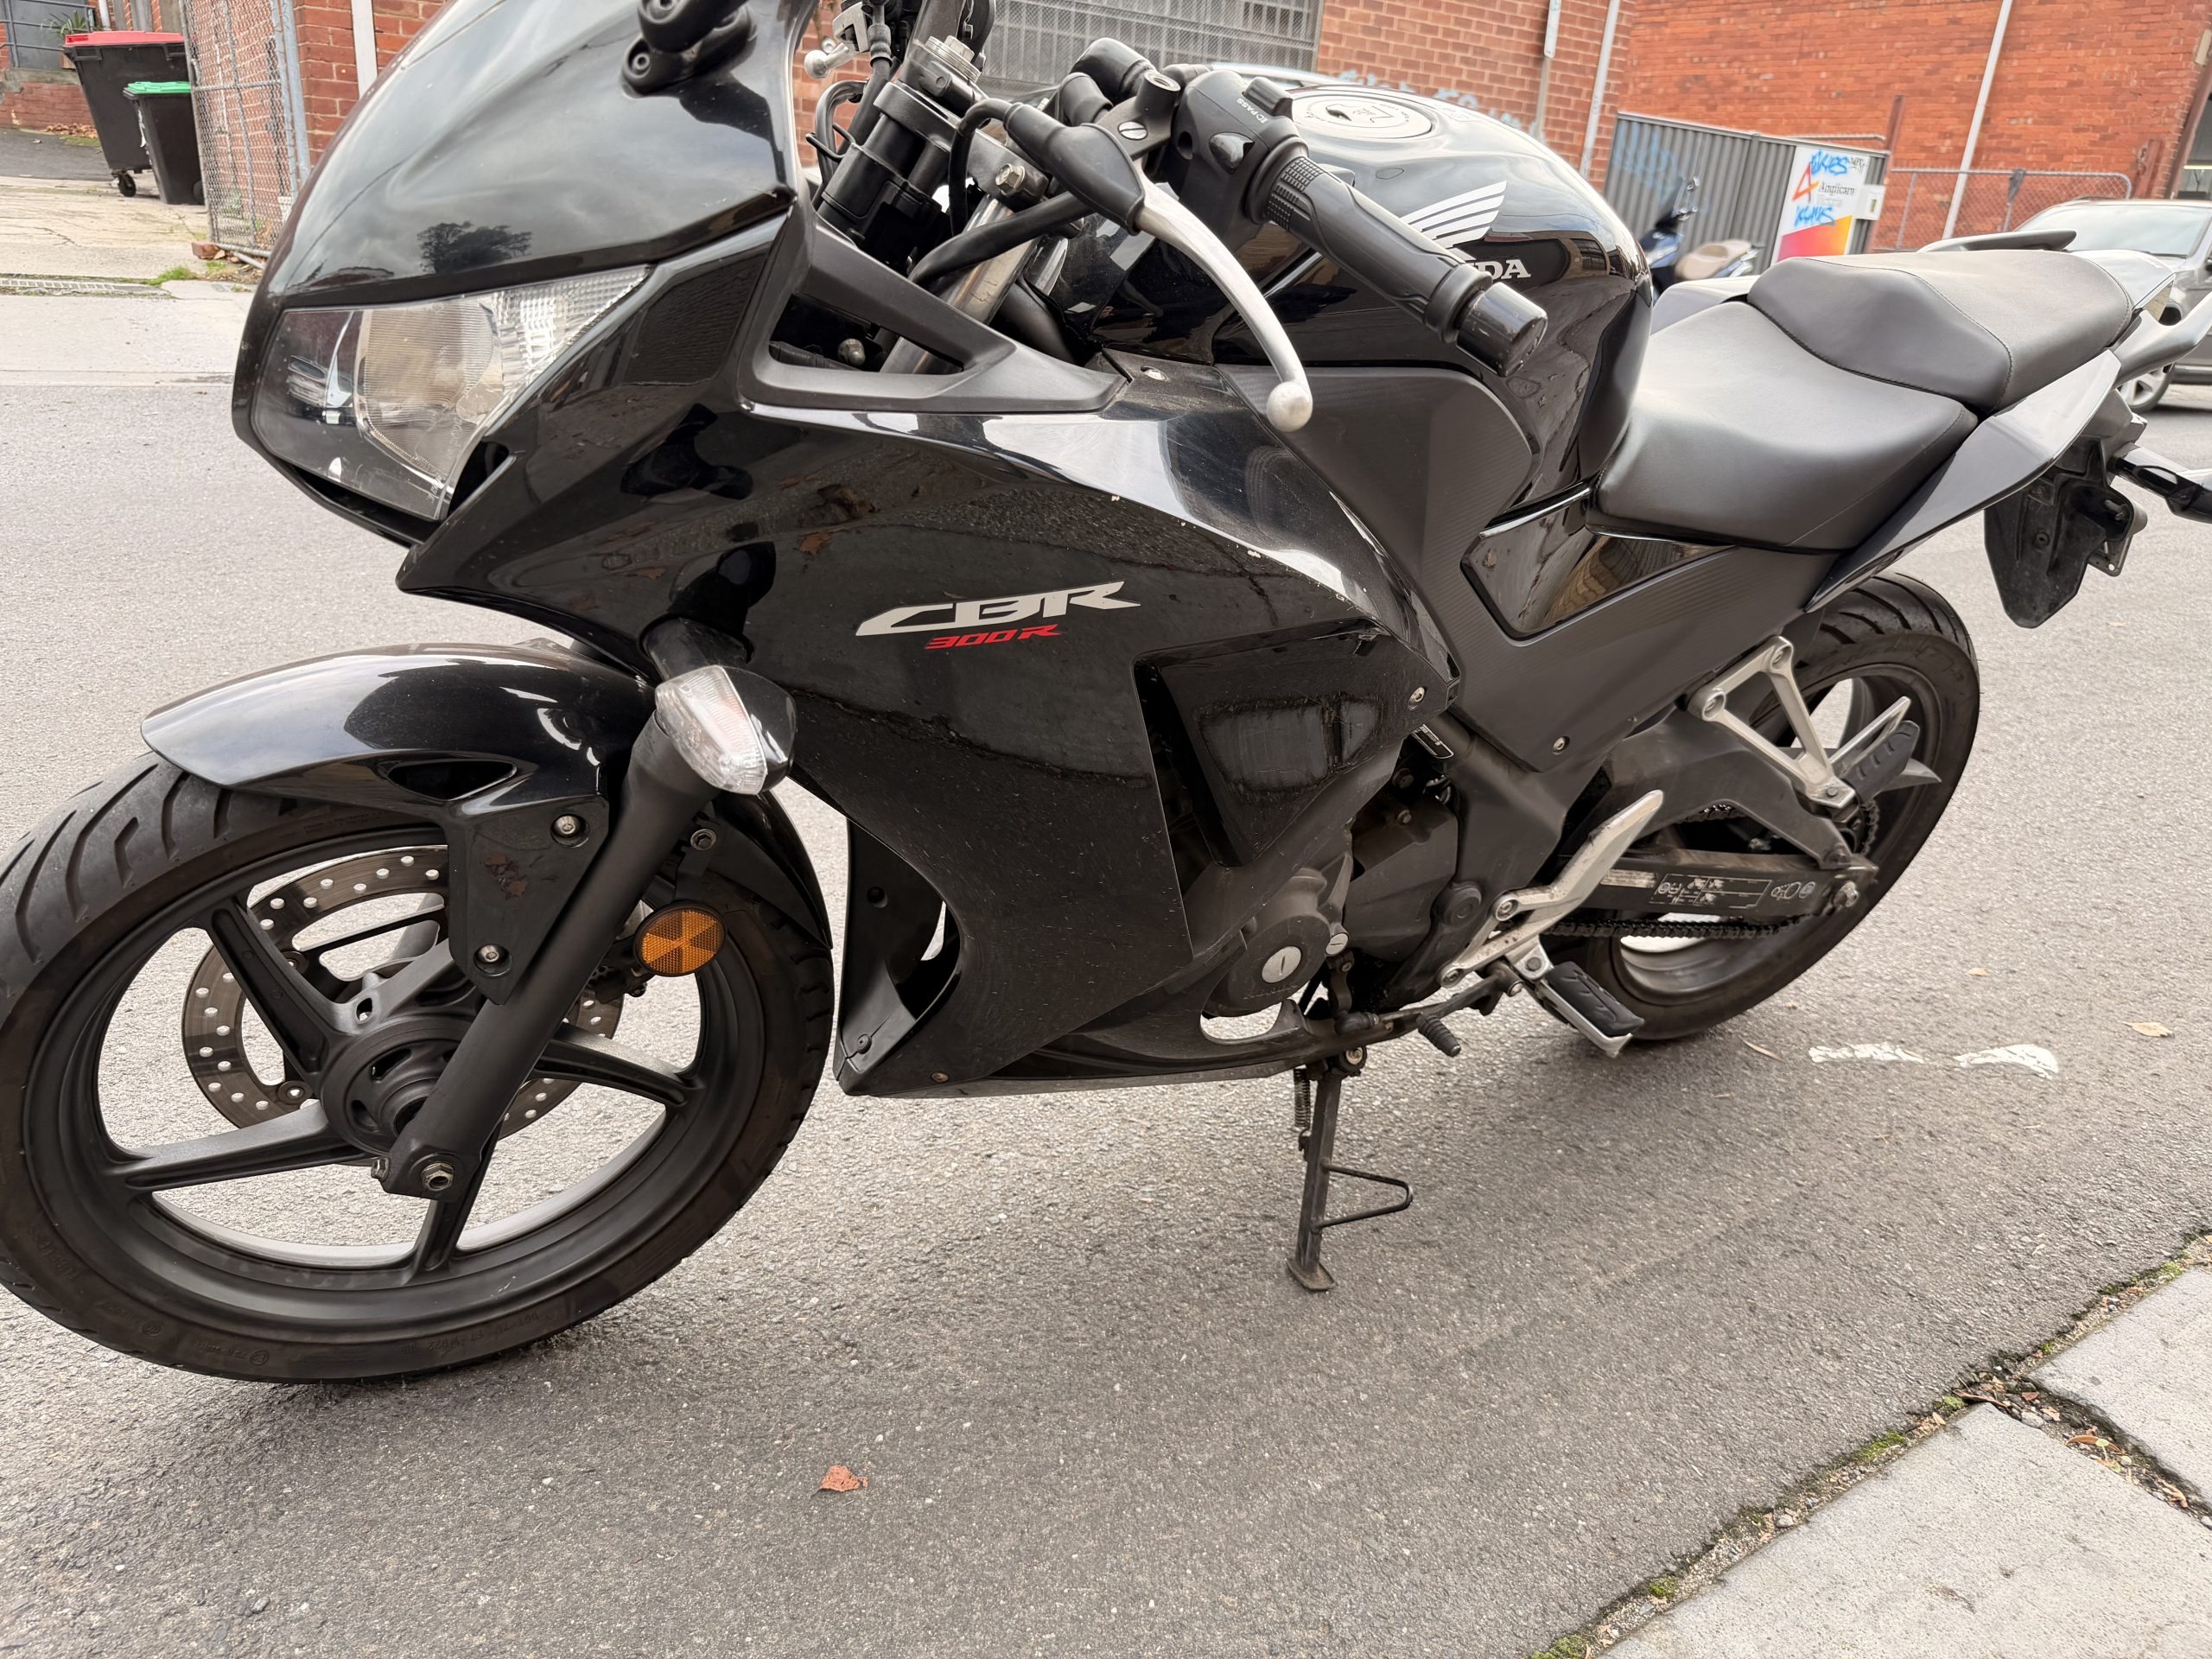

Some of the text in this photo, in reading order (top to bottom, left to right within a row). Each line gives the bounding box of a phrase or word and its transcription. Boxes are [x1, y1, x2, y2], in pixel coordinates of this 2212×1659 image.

[1236, 98, 1258, 115] PASS
[1467, 258, 1532, 281] DA
[855, 581, 1141, 636] CBR
[925, 624, 1062, 649] 300R
